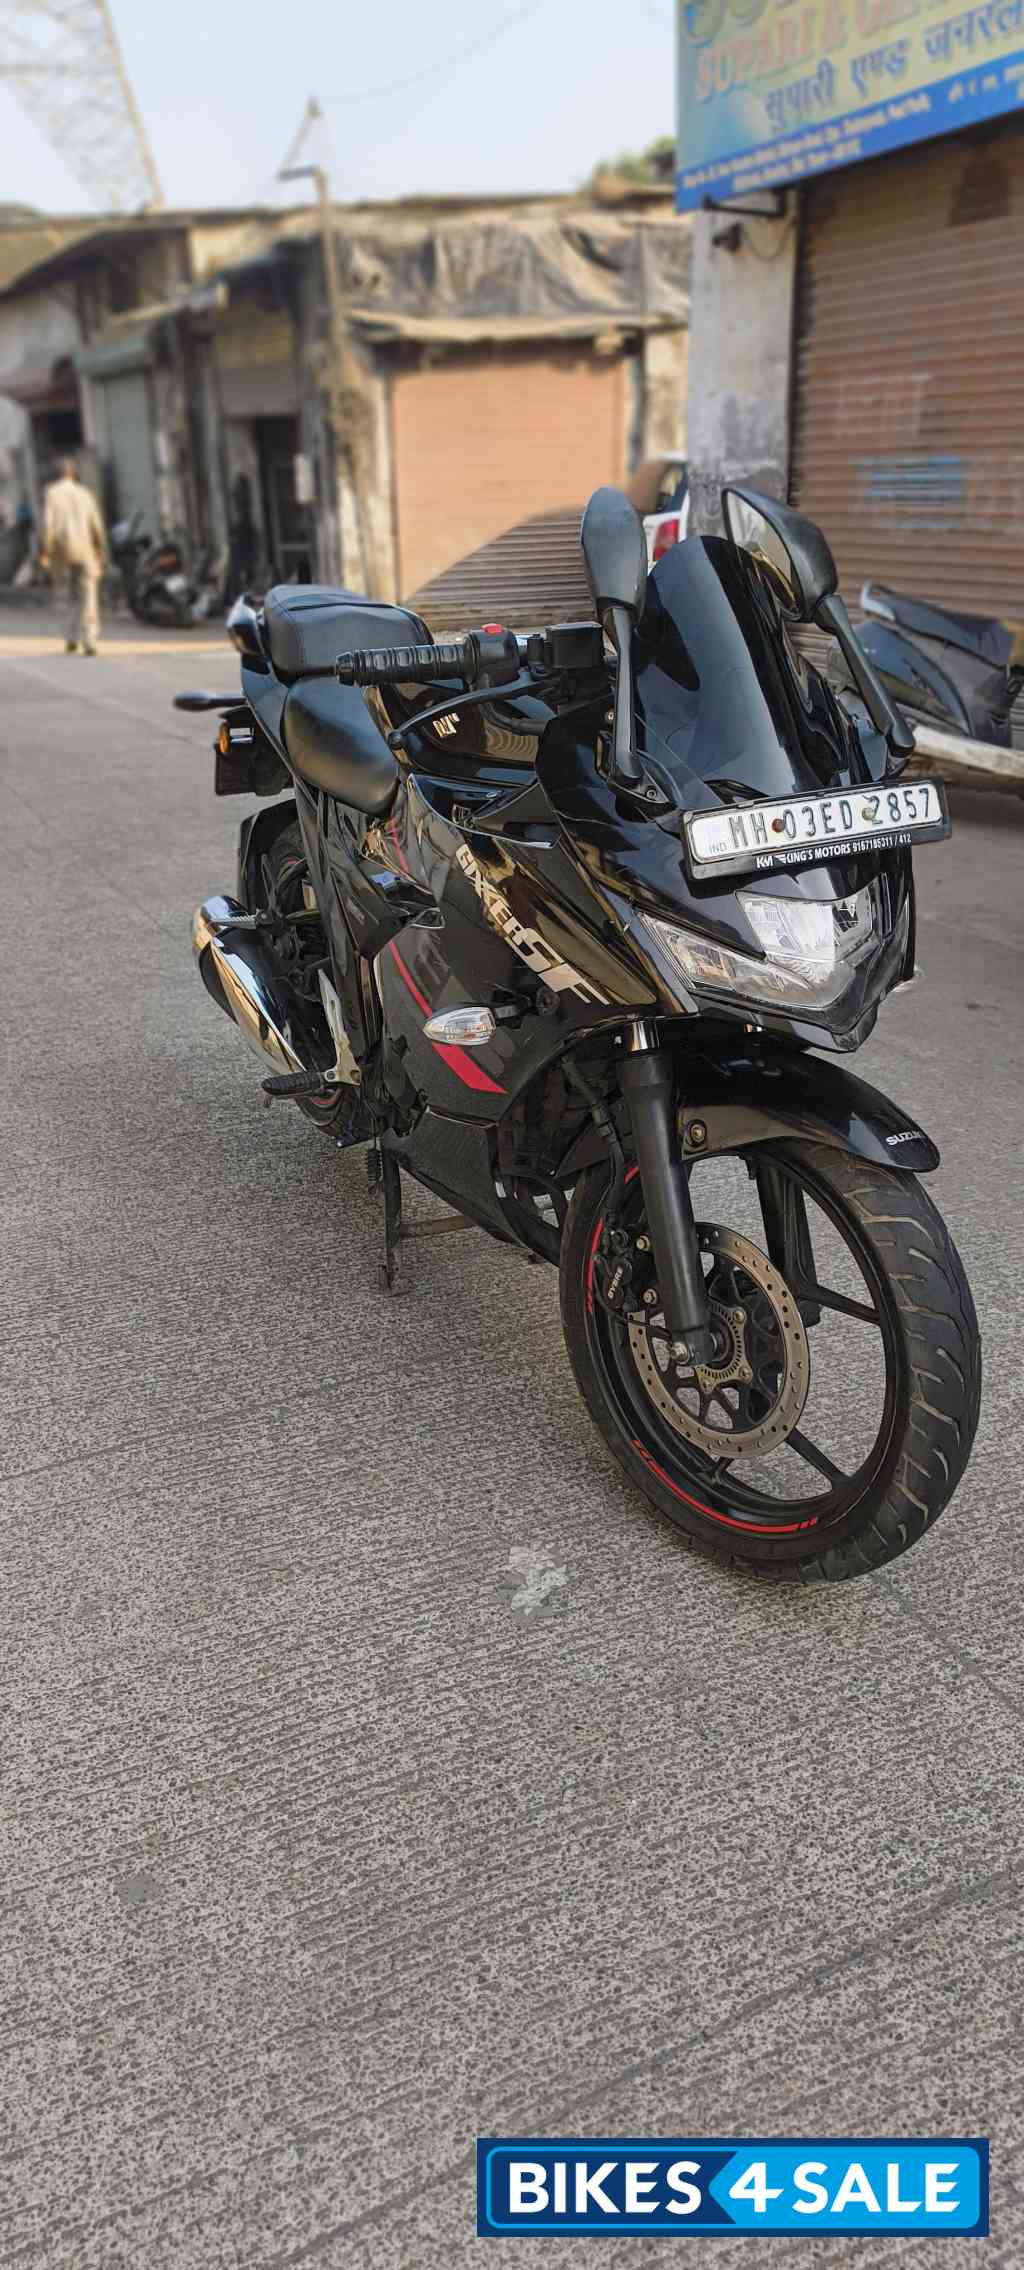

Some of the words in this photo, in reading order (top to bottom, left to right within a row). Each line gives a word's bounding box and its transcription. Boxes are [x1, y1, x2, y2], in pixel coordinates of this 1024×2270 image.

[728, 810, 769, 849] MH
[782, 800, 853, 839] 03ED
[863, 788, 929, 825] 2857
[814, 843, 851, 859] MOTORS
[505, 927, 611, 1005] SF
